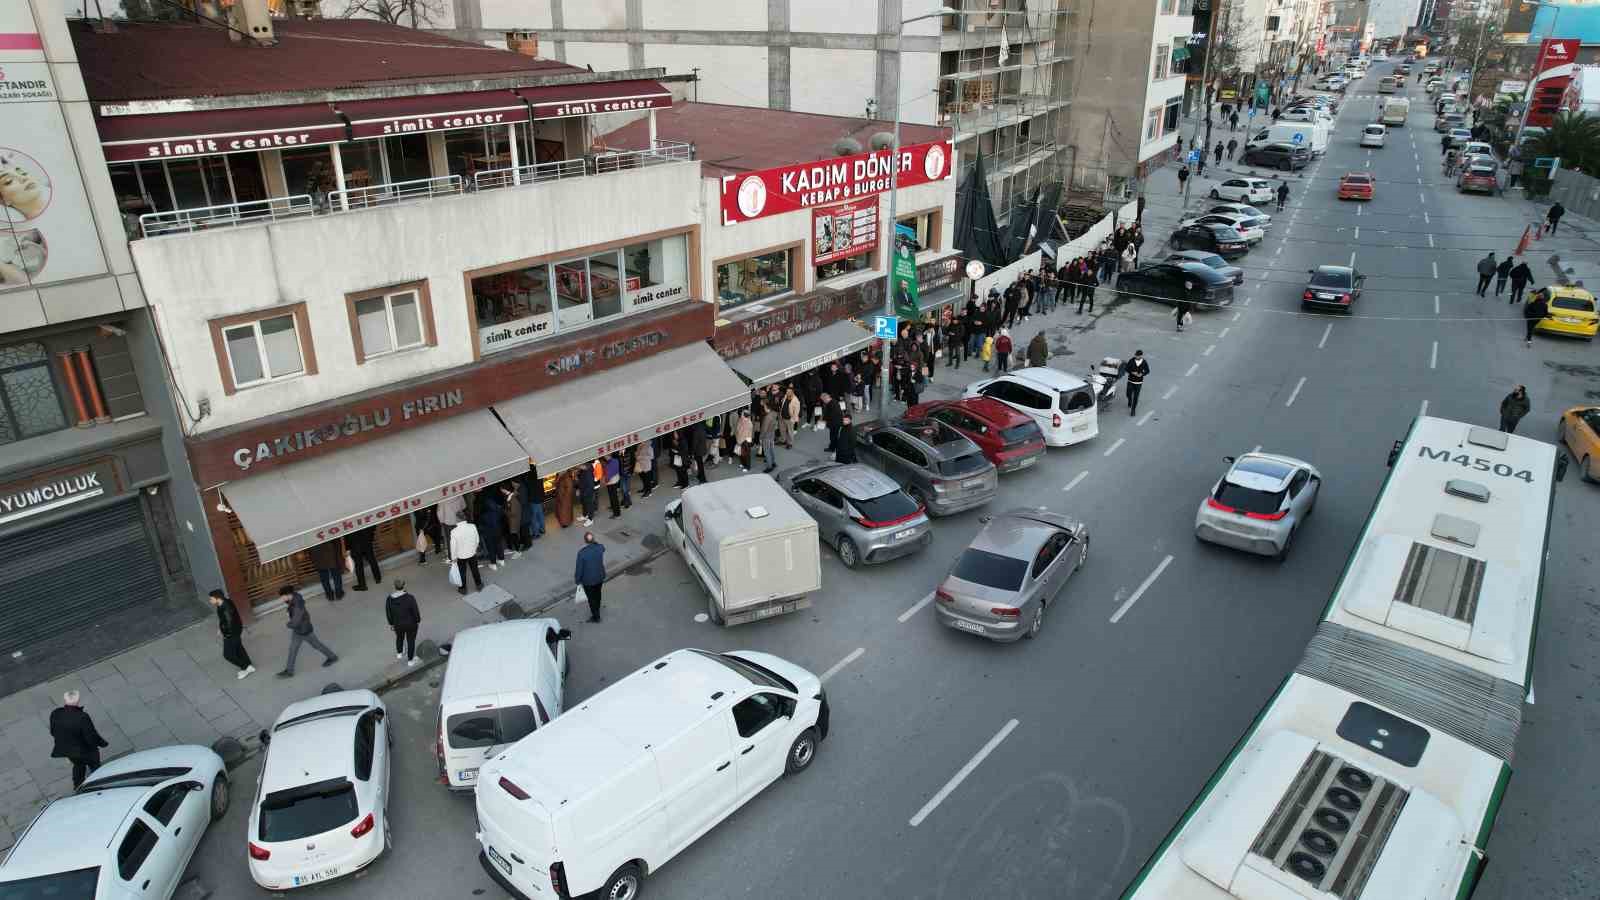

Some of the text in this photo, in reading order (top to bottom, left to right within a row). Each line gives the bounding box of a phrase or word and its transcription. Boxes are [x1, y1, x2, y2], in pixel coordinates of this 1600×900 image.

[556, 98, 653, 117] simit center
[383, 111, 504, 134] simit center
[147, 132, 310, 158] simit center
[801, 189, 840, 206] KEBAP
[854, 175, 896, 195] BURGE
[633, 286, 682, 306] simit center
[486, 320, 548, 345] simit center
[876, 317, 888, 335] P
[233, 389, 464, 470] ÇAKIROĞLU FIRIN
[597, 411, 704, 455] simit center
[1418, 446, 1535, 483] M4504
